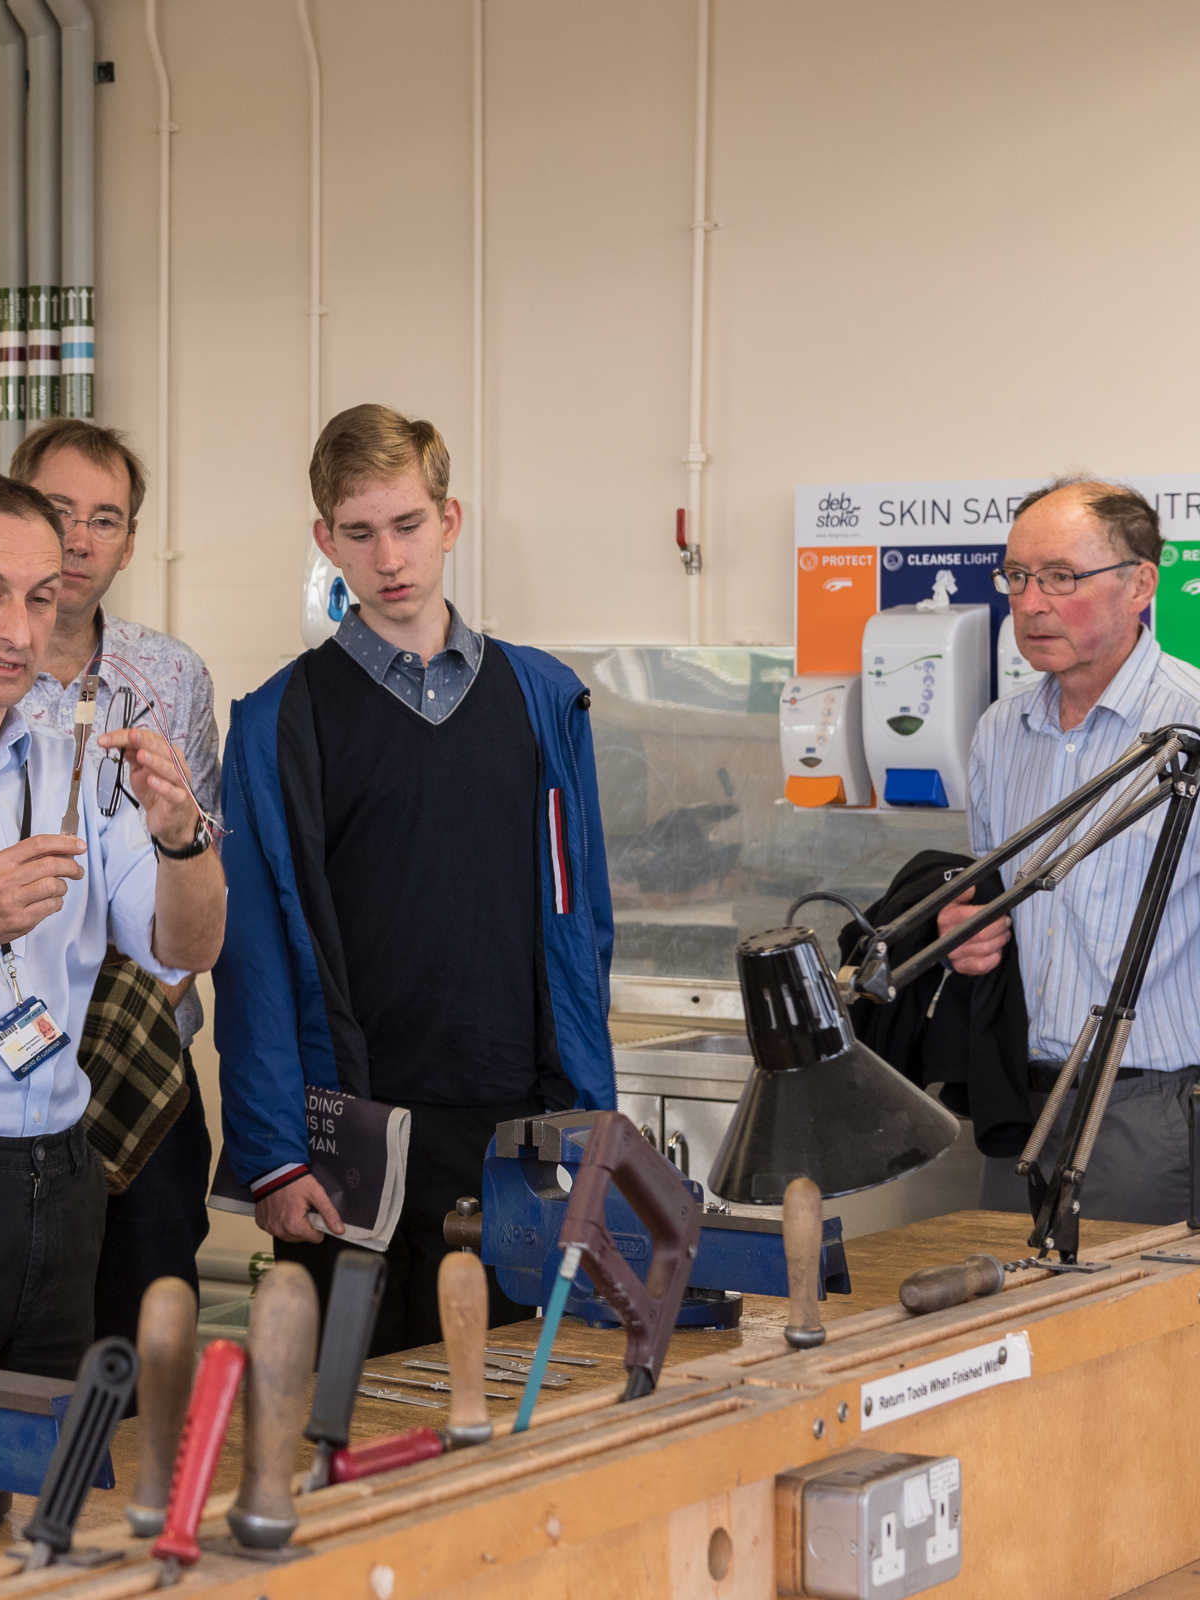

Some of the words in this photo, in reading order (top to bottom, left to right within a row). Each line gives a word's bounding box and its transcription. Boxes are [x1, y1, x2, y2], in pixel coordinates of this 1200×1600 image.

[819, 492, 852, 512] deb
[816, 511, 860, 528] stoko
[879, 498, 951, 527] SKIN
[822, 554, 873, 566] PROTECT
[907, 553, 961, 566] CLEANSE
[963, 552, 999, 565] LIGHT
[322, 1118, 335, 1134] IS
[879, 1392, 905, 1409] Return
[907, 1383, 928, 1400] Tools
[930, 1376, 950, 1392] When
[952, 1365, 983, 1385] Finished
